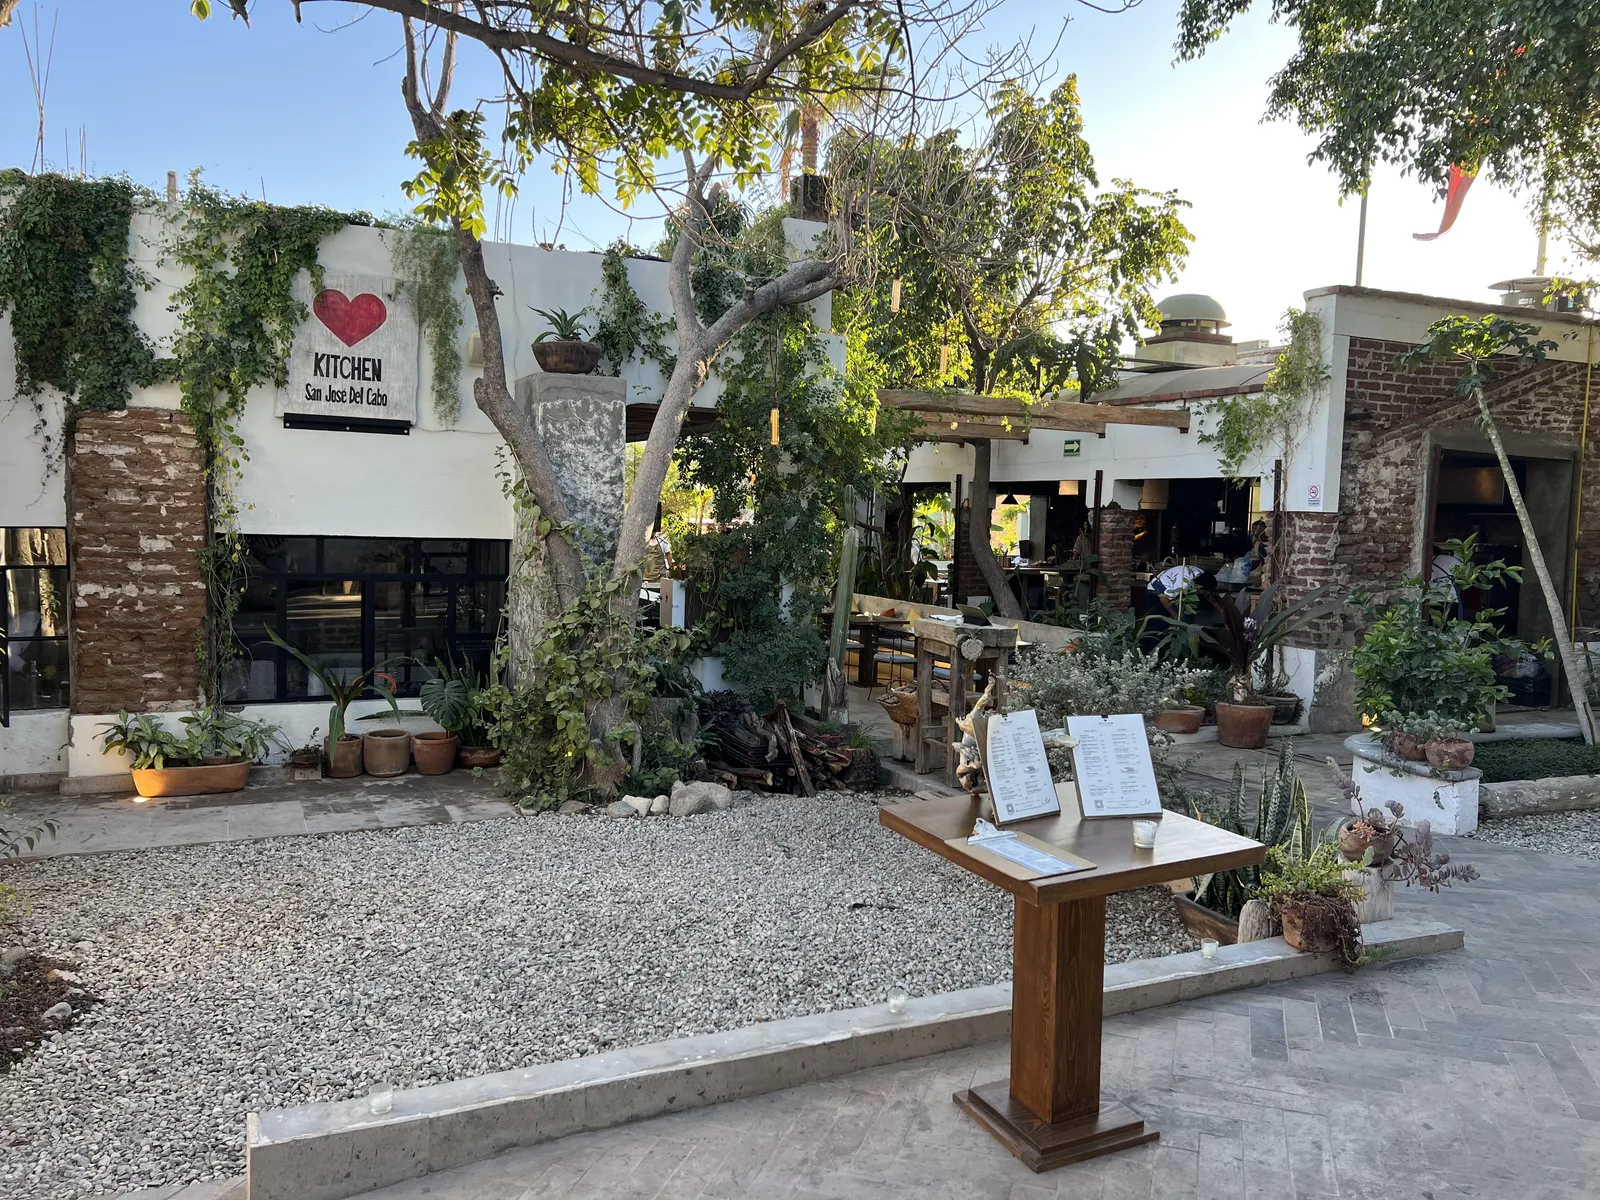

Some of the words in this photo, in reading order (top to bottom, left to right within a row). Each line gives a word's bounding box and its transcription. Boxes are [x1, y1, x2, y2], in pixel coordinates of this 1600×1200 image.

[314, 352, 381, 382] KITCHEN
[305, 383, 322, 401] San
[349, 386, 363, 404] Del
[367, 388, 387, 406] Cabo
